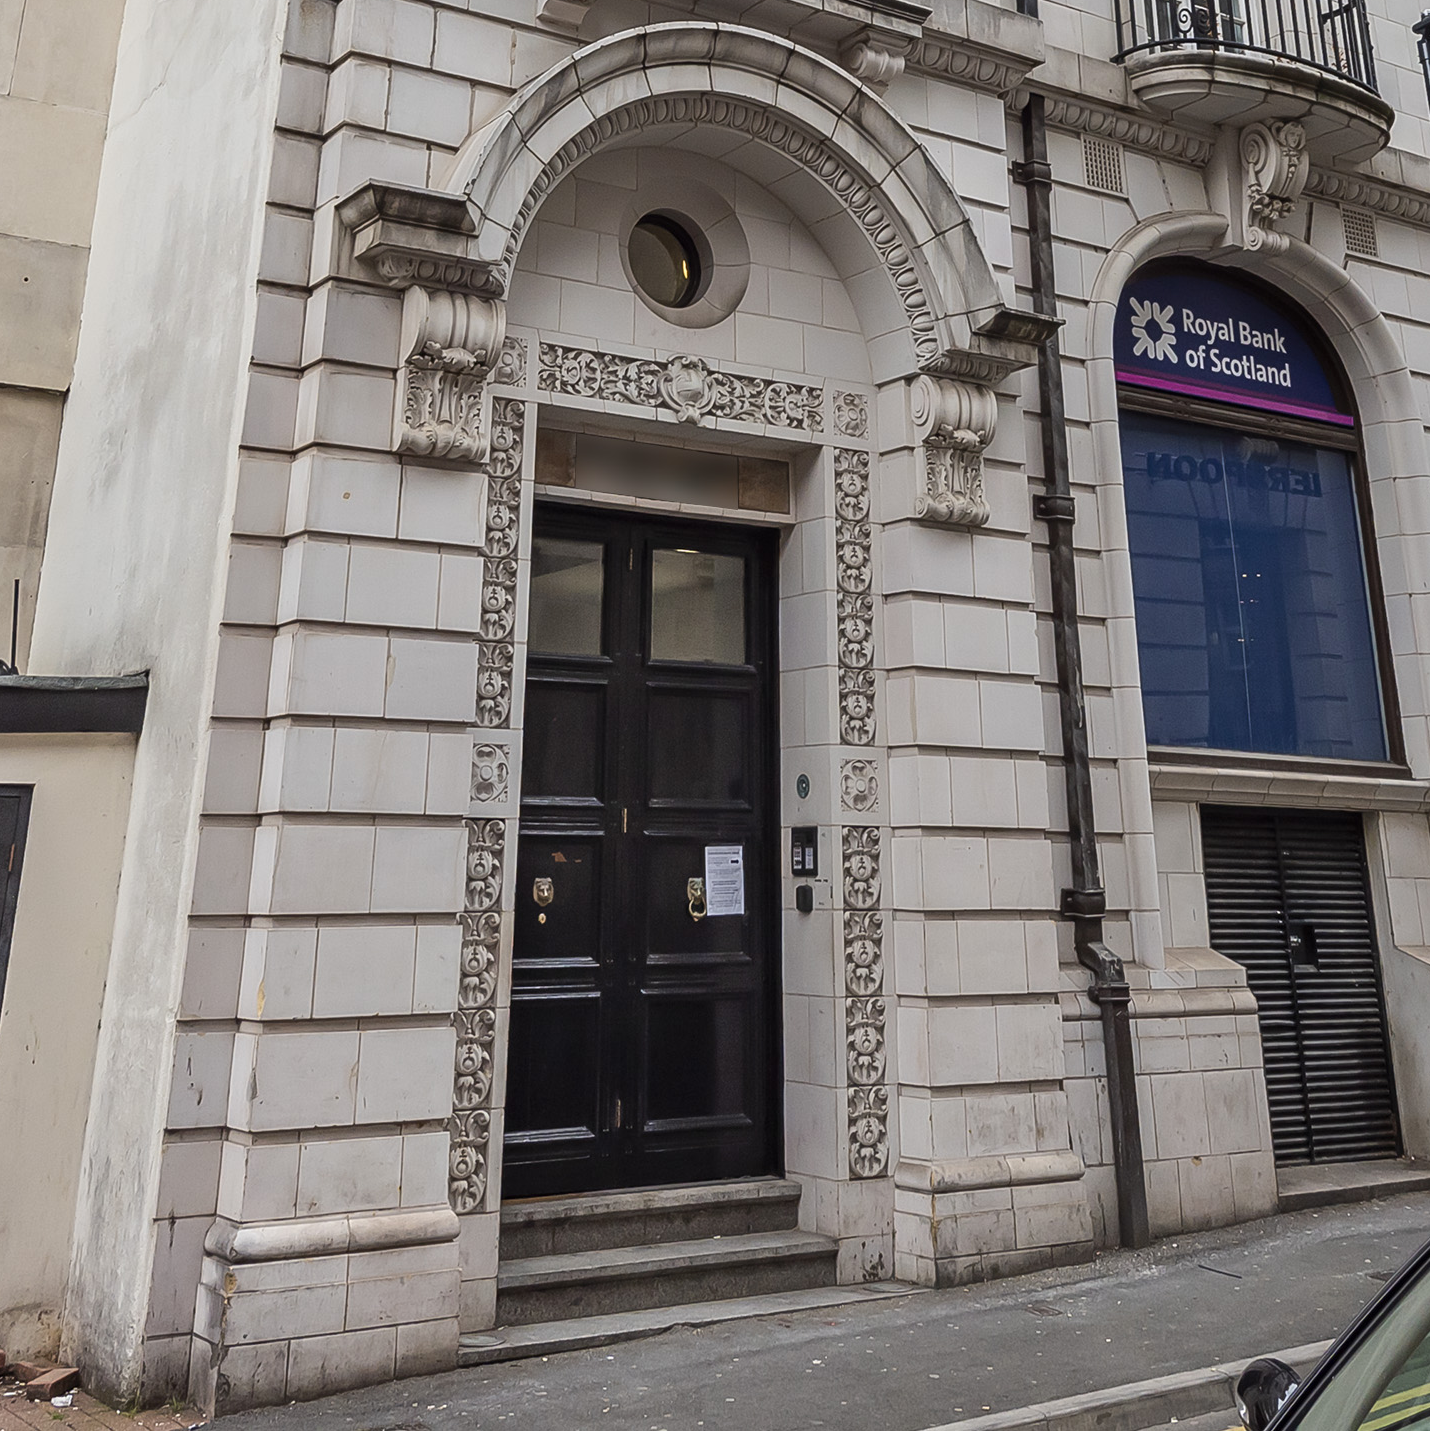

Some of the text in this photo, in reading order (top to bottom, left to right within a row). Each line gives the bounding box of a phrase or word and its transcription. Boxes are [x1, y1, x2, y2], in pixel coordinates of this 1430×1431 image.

[1182, 308, 1287, 354] Royal Bank
[1185, 345, 1292, 387] of Scotland
